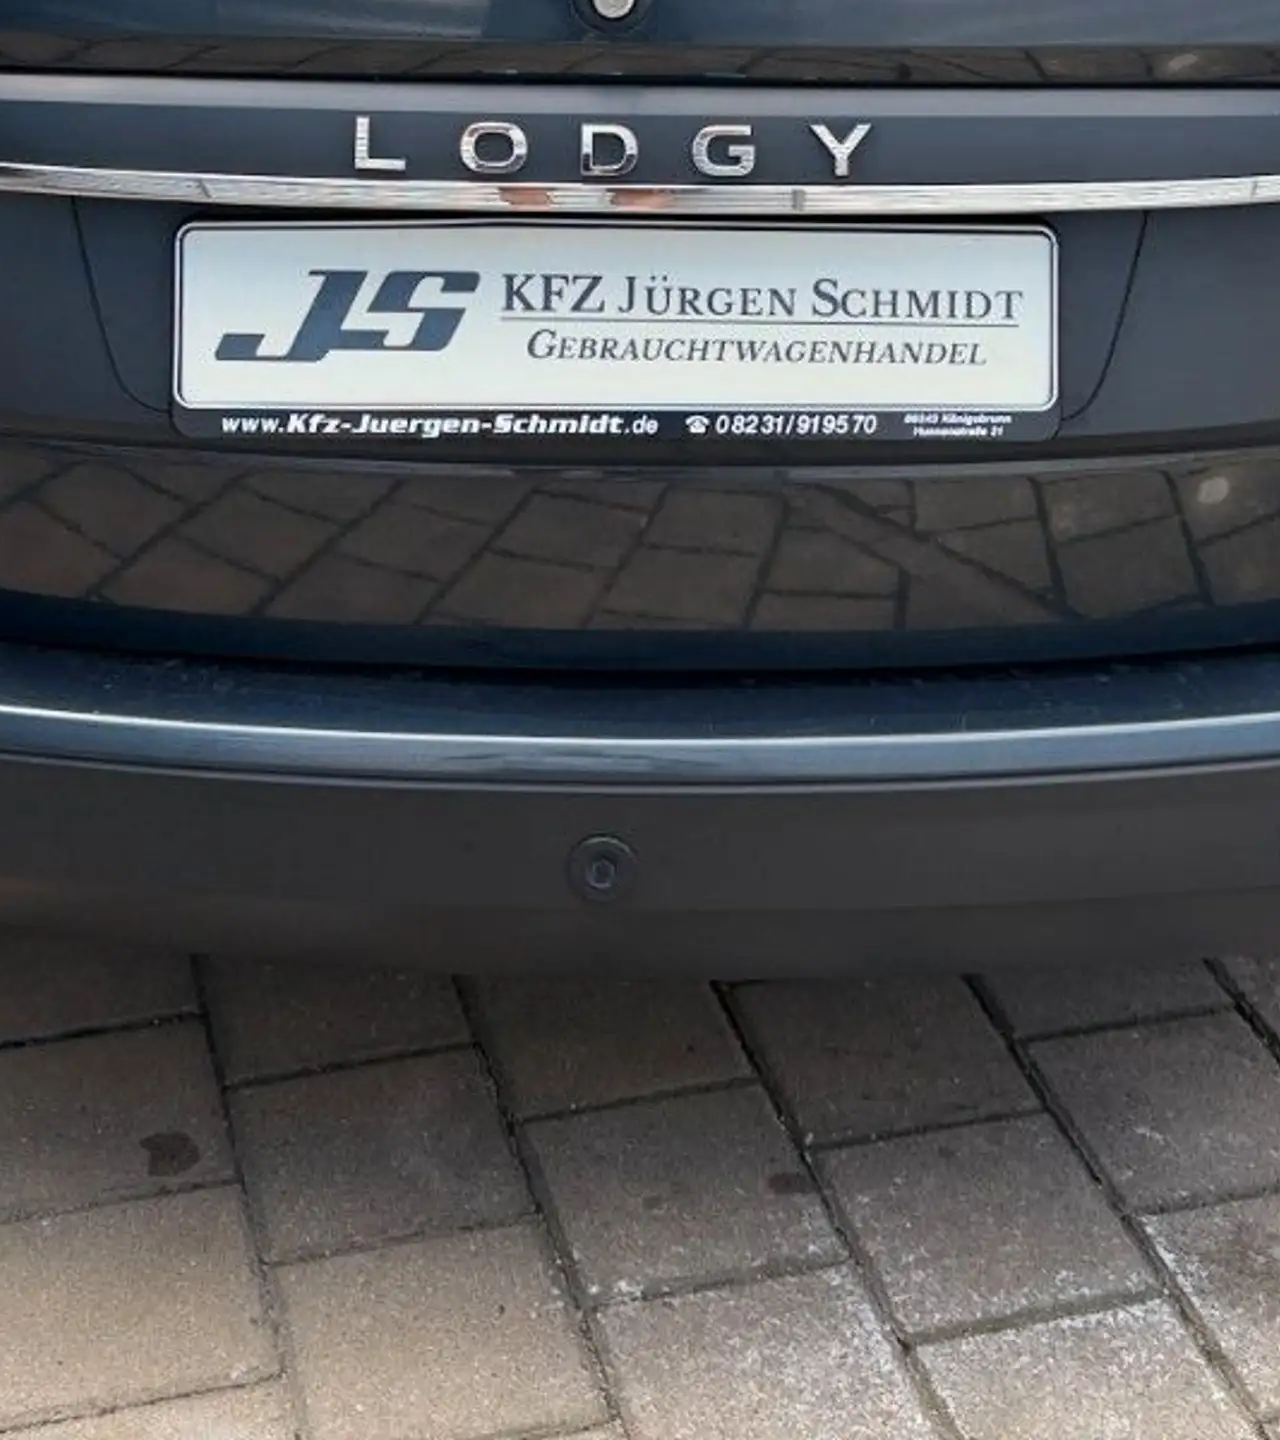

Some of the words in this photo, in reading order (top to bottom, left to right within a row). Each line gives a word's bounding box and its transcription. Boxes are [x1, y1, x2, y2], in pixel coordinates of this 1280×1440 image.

[354, 116, 872, 178] LODGY
[214, 269, 481, 363] JS
[501, 273, 607, 314] KFZ
[616, 275, 797, 317] JÜRGEN
[811, 277, 1024, 320] SCHMIDT
[526, 328, 988, 366] GEBRAUCHTWAGENHANDEL
[221, 413, 659, 438] www.Kfz-Juergen-Schmidt.de
